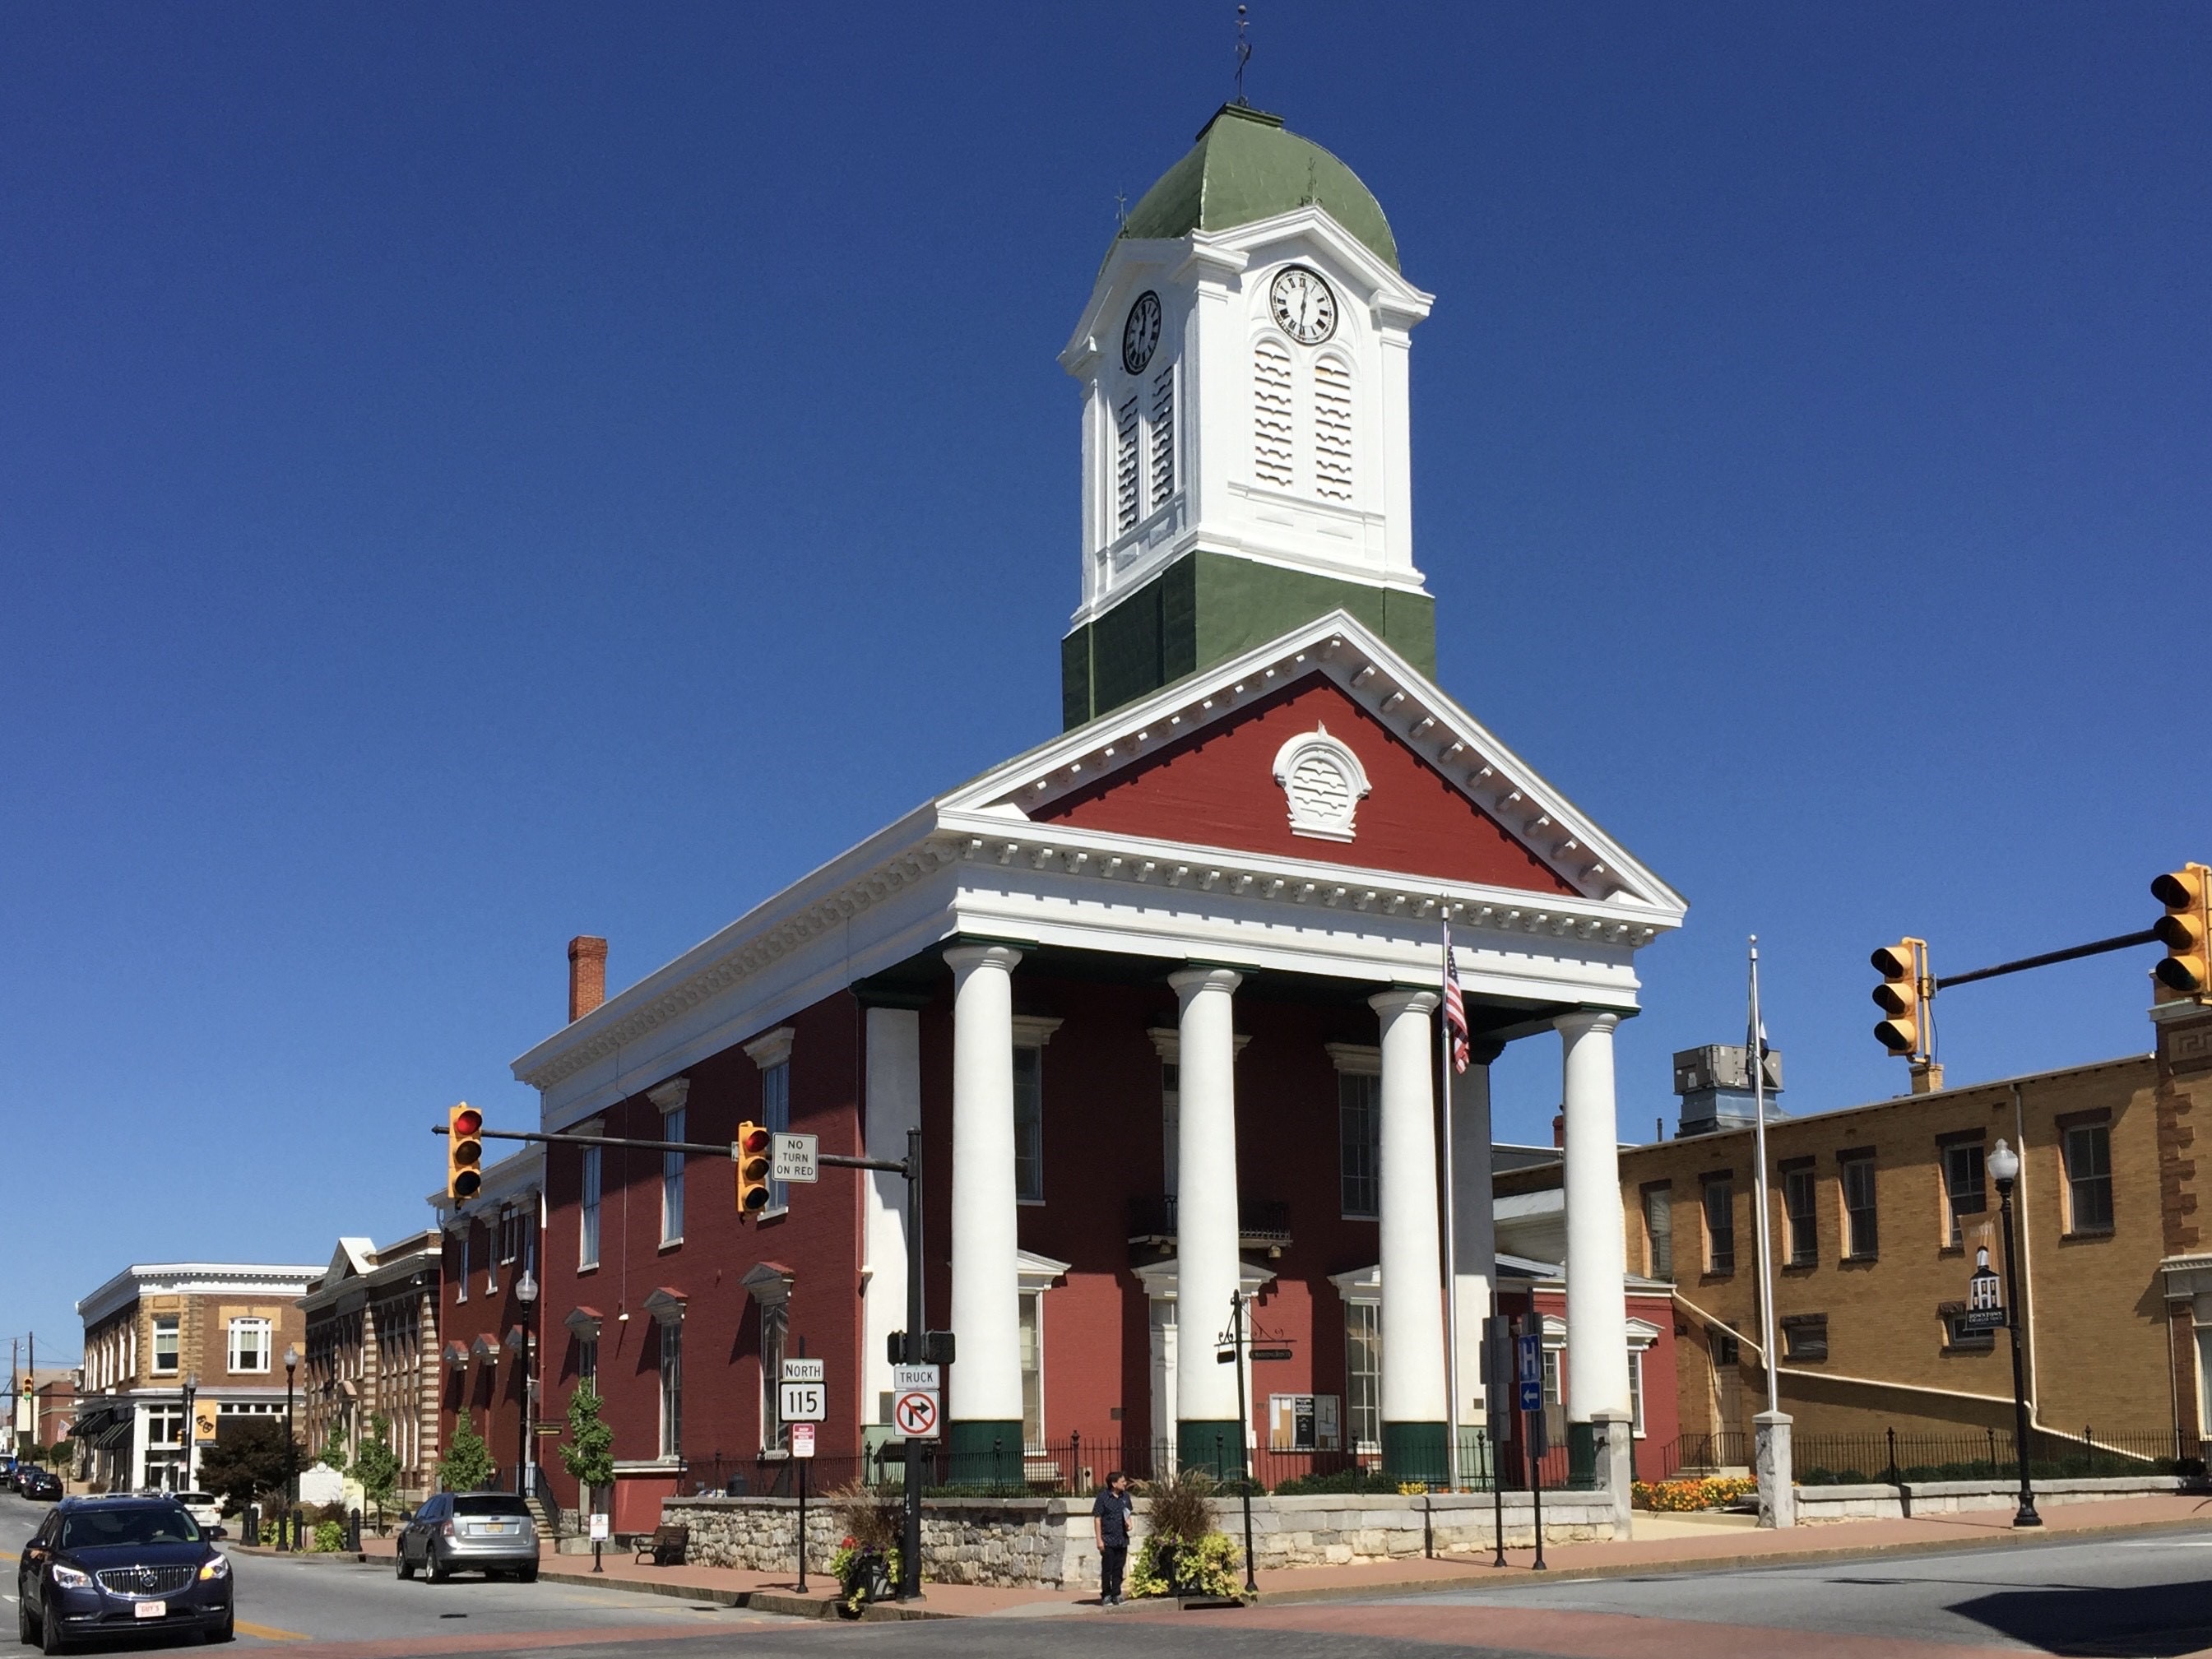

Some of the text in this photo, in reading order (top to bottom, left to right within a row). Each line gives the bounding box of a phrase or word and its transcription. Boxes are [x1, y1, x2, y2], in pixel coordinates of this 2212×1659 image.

[788, 1140, 803, 1150] NO
[783, 1152, 808, 1162] TURN
[777, 1165, 814, 1176] ON RED
[1523, 1342, 1536, 1375] H
[786, 1364, 820, 1377] NORTH
[900, 1371, 933, 1383] TRUCK
[790, 1391, 817, 1413] 115
